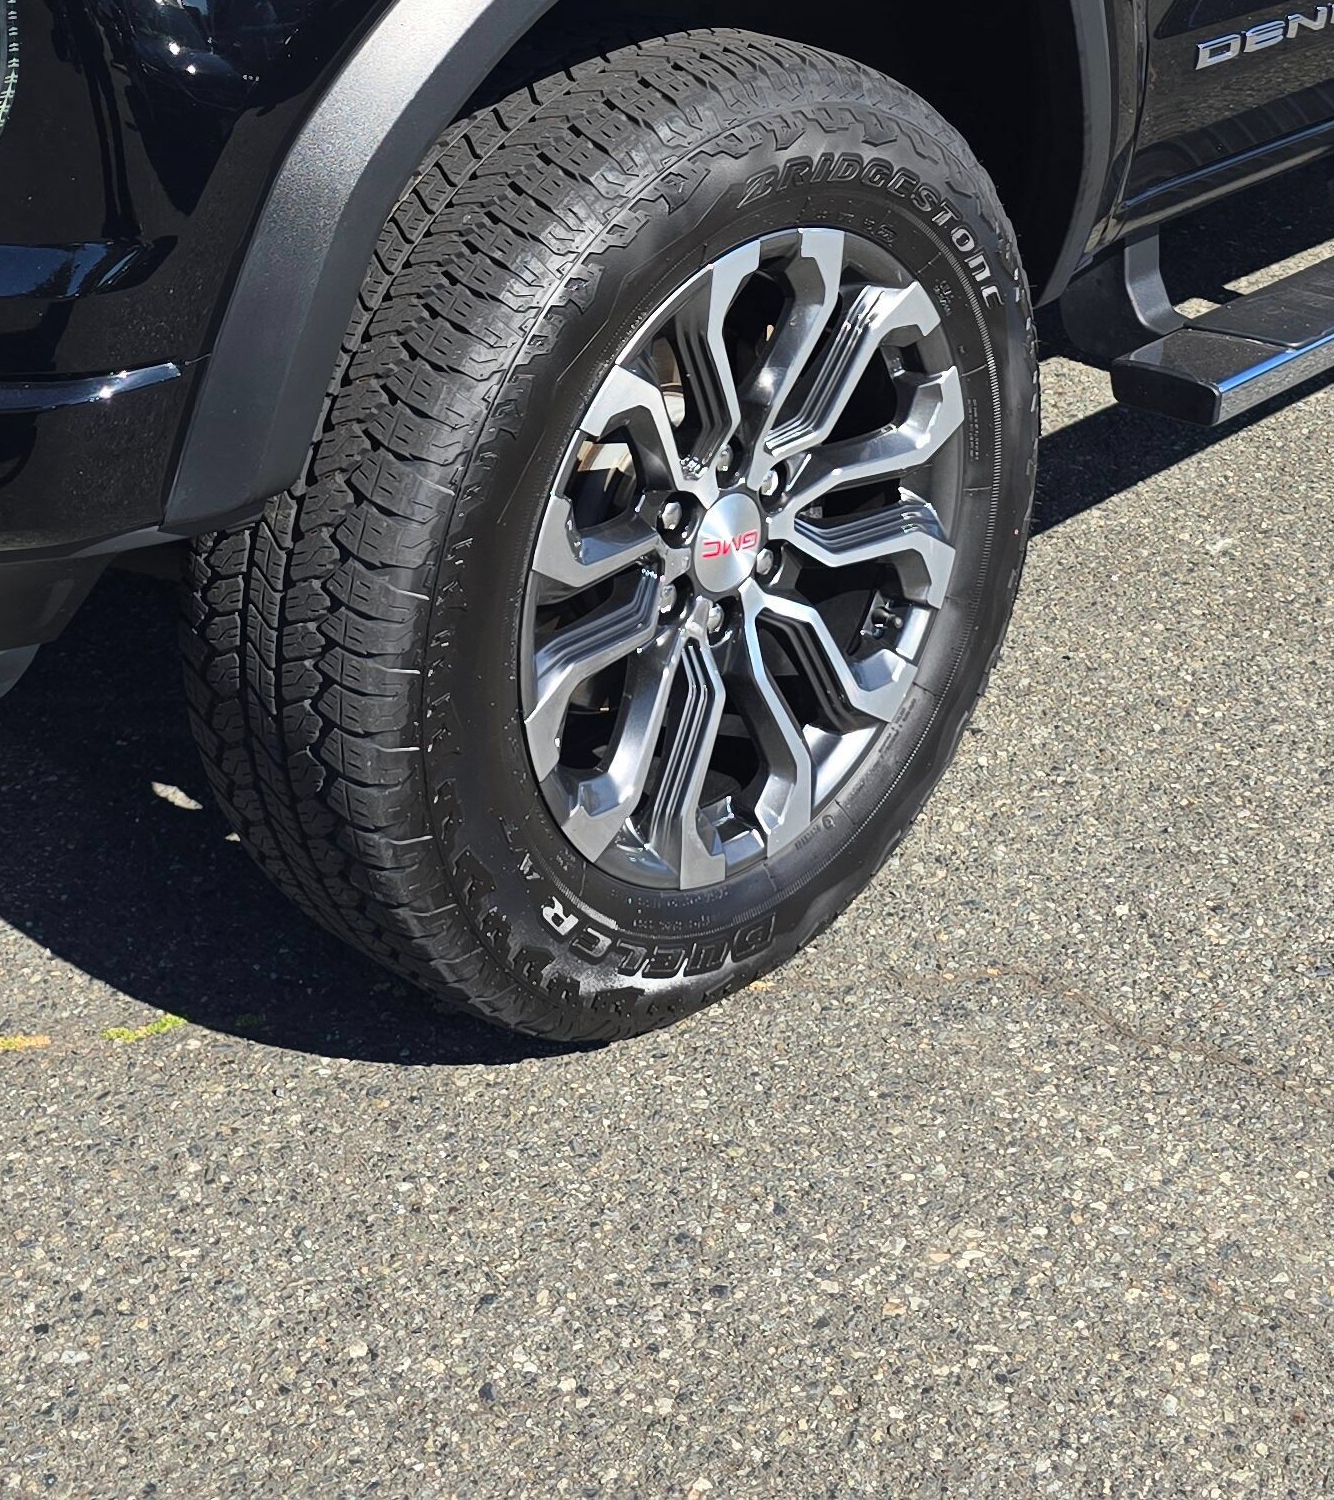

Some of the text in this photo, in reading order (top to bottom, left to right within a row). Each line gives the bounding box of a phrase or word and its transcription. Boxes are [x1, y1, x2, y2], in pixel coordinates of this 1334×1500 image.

[736, 151, 1005, 310] BRIDGESTONE
[701, 530, 758, 558] GMC
[540, 895, 776, 979] DUELER
